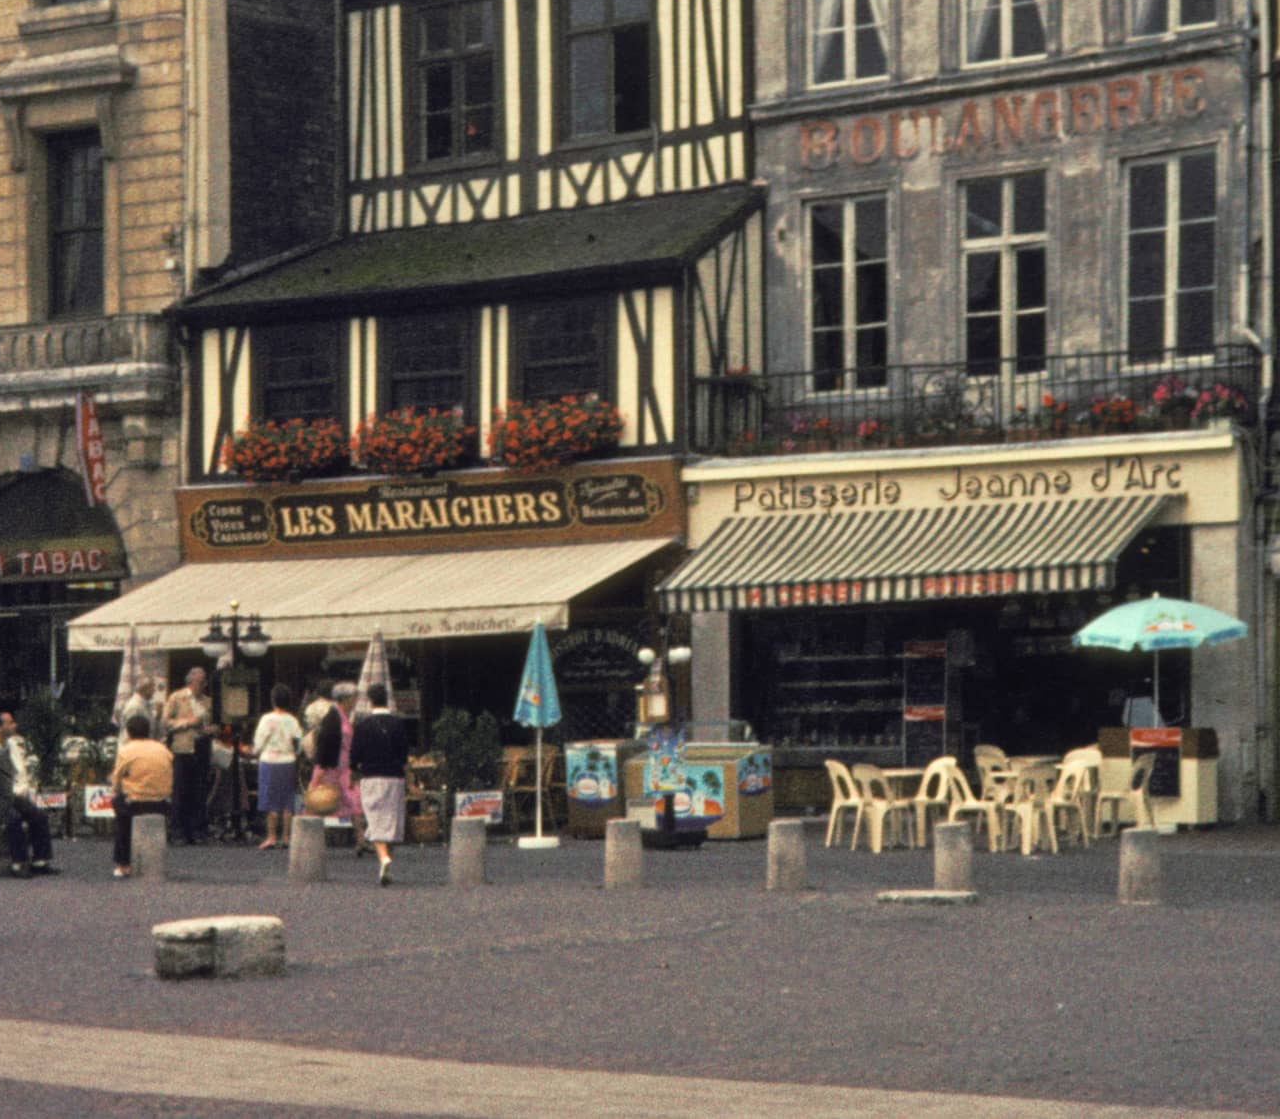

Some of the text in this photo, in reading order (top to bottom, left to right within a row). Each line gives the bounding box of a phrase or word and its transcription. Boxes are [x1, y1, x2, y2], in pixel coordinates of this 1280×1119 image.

[798, 65, 1208, 172] BOULANGERIE
[938, 465, 1073, 502] Jeanne
[1090, 456, 1182, 493] d'Arc
[280, 490, 562, 538] LES MARAICHERS
[16, 548, 104, 575] TABAC
